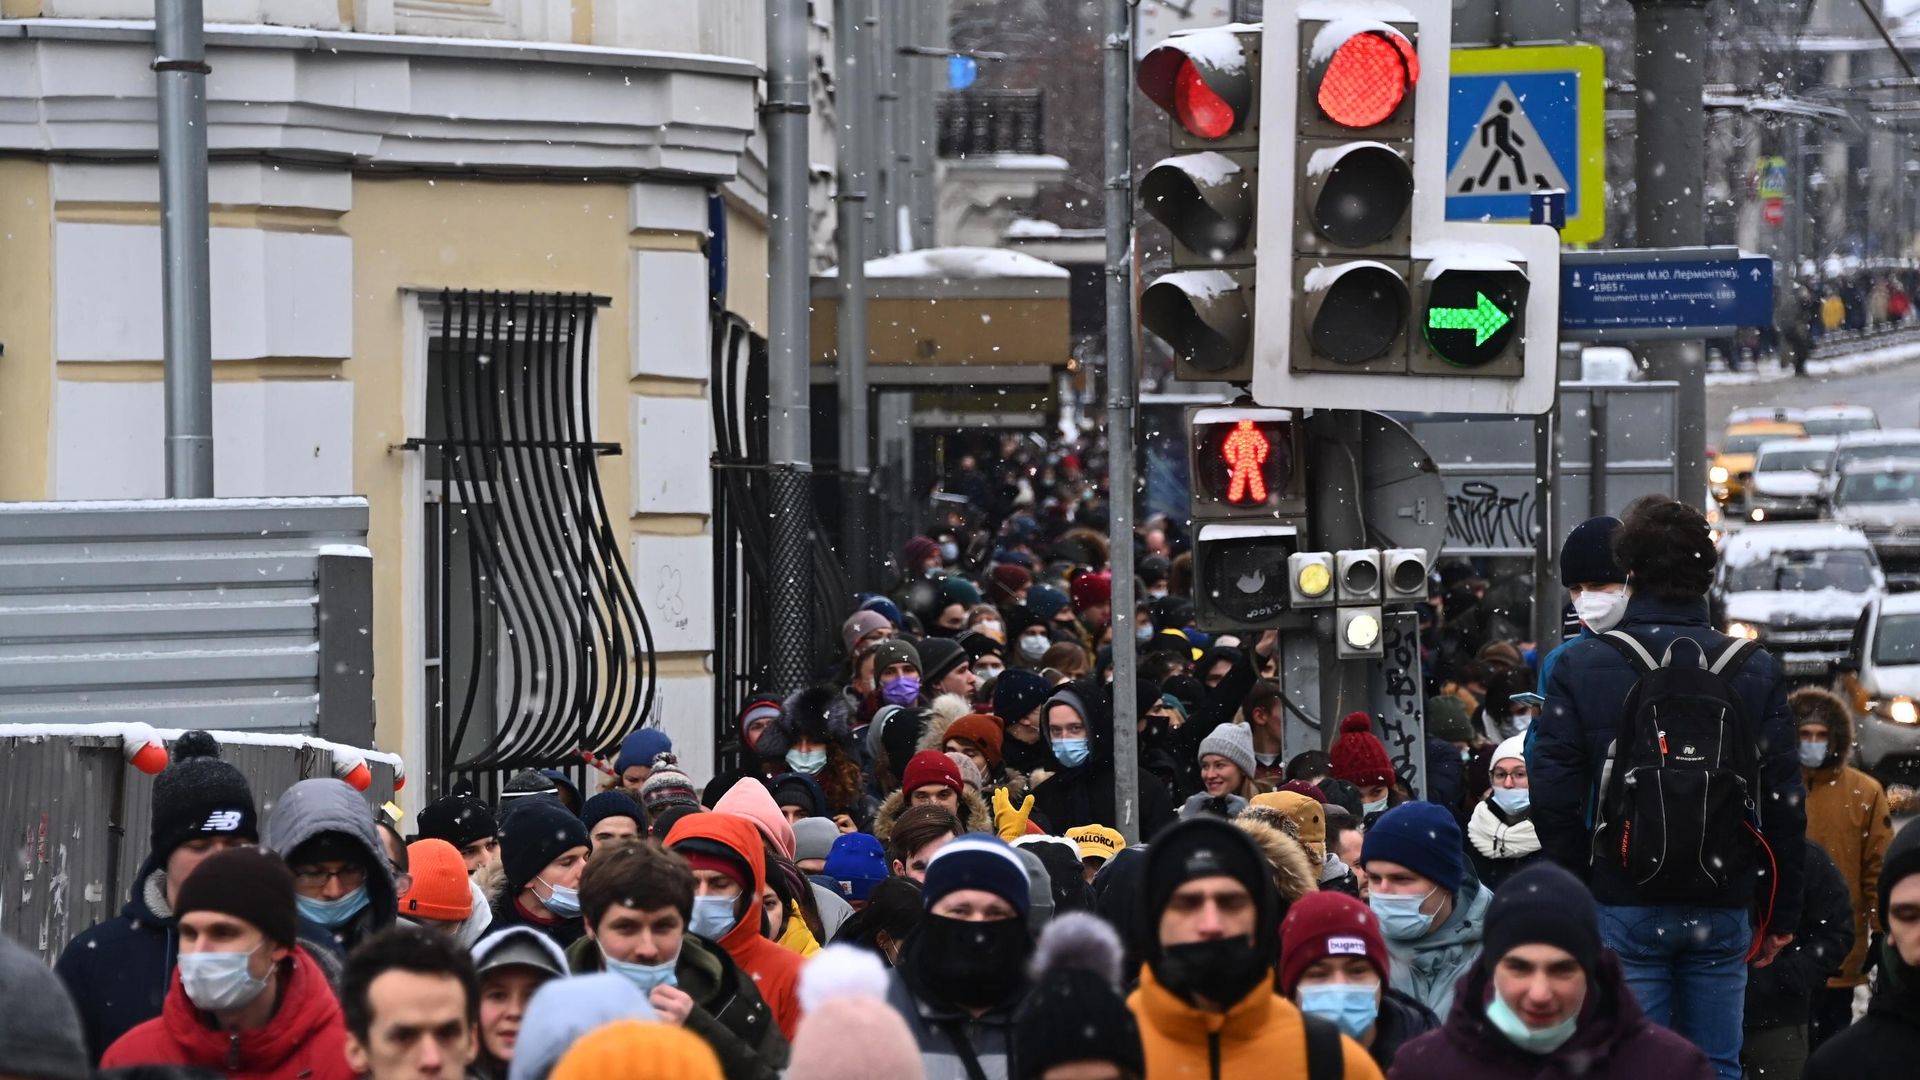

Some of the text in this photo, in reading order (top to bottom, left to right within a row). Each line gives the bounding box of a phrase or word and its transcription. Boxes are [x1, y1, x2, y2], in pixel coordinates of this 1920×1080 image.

[1593, 271, 1646, 281] Памятник
[1593, 294, 1637, 302] Monument
[1072, 834, 1115, 850] MALLORCA
